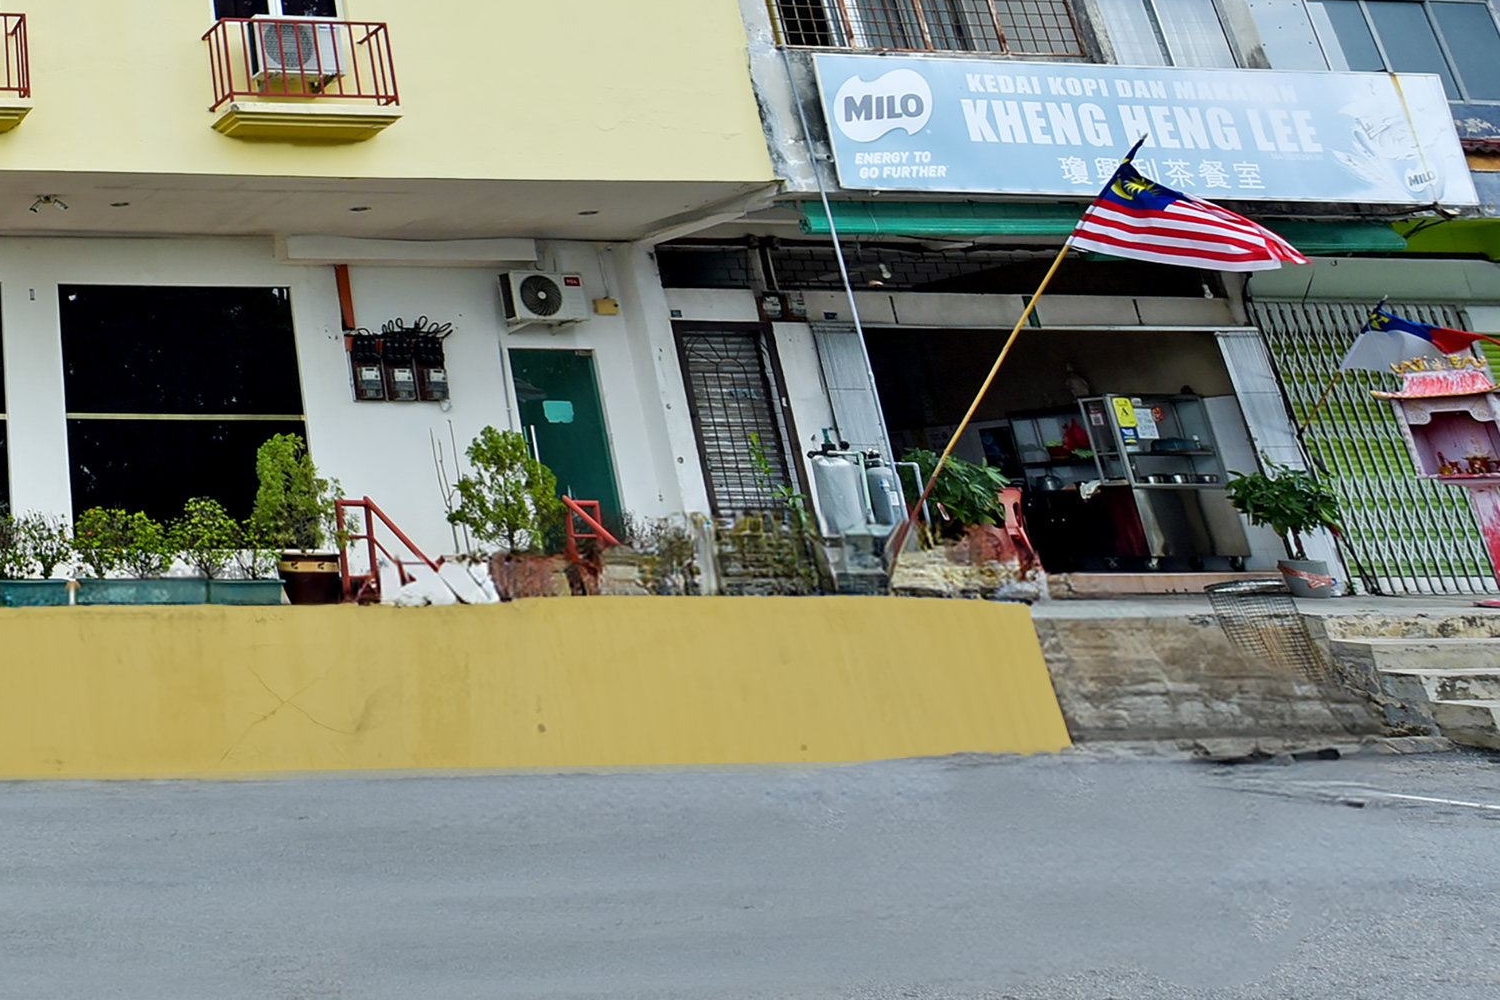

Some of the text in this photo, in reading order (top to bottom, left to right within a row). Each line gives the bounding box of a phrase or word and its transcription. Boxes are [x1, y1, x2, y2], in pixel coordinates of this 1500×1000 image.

[966, 74, 1042, 95] KEDAI
[1047, 76, 1109, 97] KOPI
[1114, 79, 1167, 99] DAN
[844, 93, 924, 122] MILO
[960, 99, 1324, 153] KHENG HENG LEE
[855, 151, 931, 165] ENERGY TO
[860, 165, 947, 179] GO FURTHER
[1408, 170, 1436, 187] MILO
